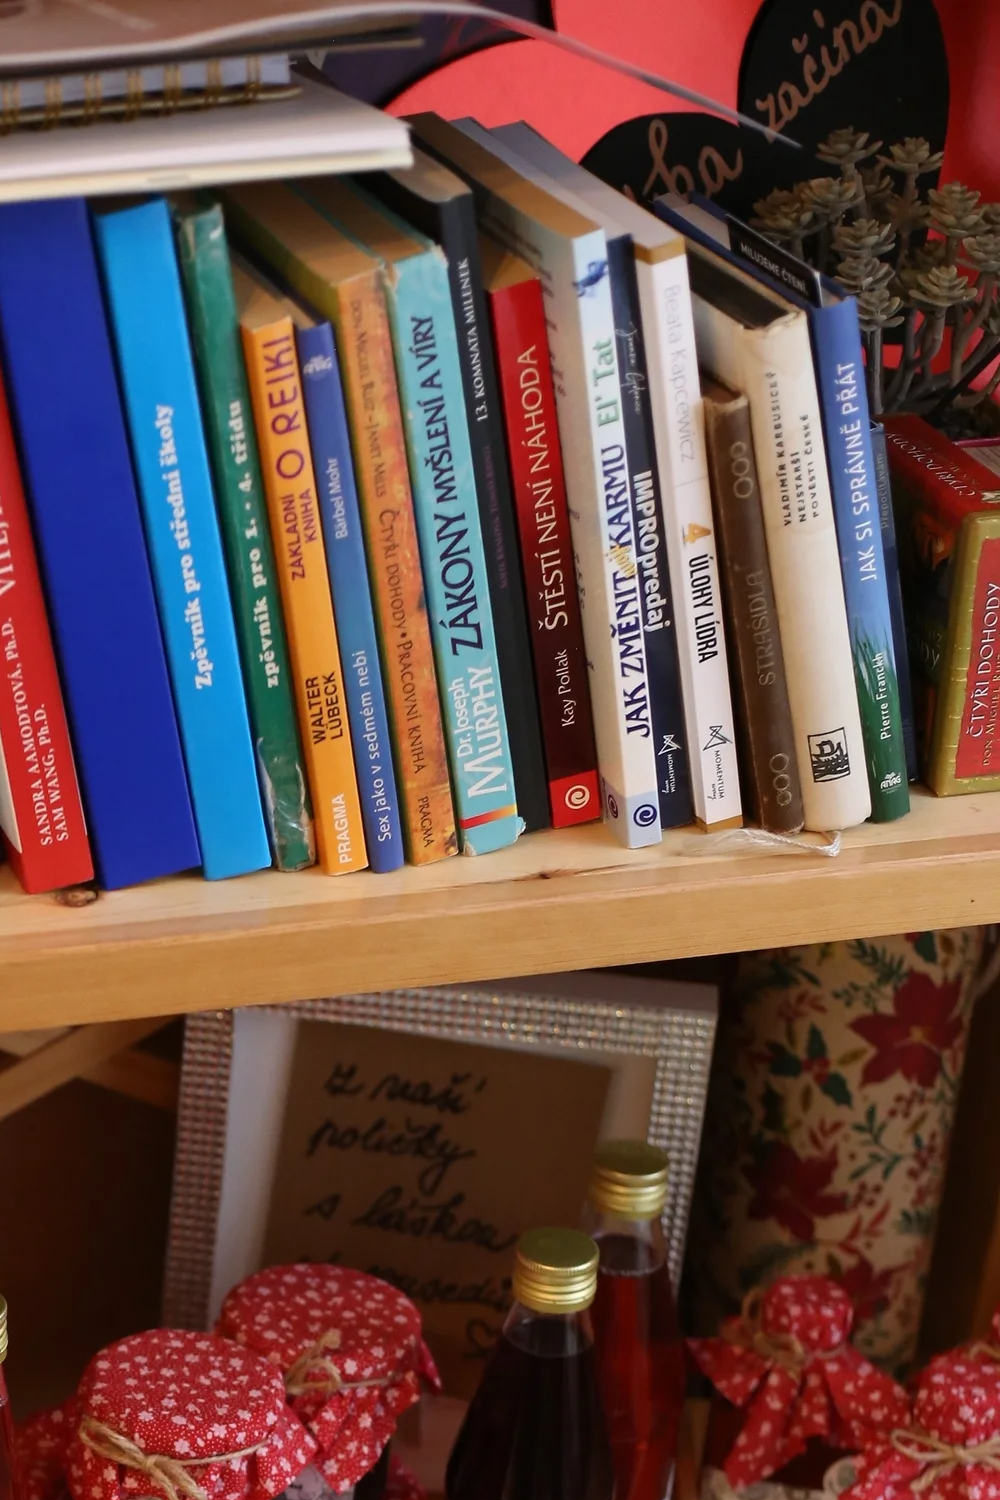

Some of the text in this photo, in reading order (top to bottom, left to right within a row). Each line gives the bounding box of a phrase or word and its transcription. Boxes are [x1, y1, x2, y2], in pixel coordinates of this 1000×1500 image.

[456, 257, 489, 422] 13. KOMNATA MILENEK
[591, 336, 616, 389] Tat
[663, 284, 695, 463] Beata Kapcewicz
[155, 403, 179, 468] školy
[262, 334, 306, 480] O REIKI
[764, 371, 792, 527] VLADIMÍR KARBUSICKÝ
[800, 413, 814, 456] ČESKÉ
[238, 472, 254, 493] 4.
[326, 457, 349, 541] Bärbel Mohr
[406, 315, 484, 656] ZÁKONY MYŠLENÍ A VÍRY
[517, 344, 569, 633] ŠTĚSTÍ NENÍ NÁHODA
[601, 443, 632, 550] KARMU
[790, 450, 807, 524] NEJSTARŠÍ
[832, 362, 878, 582] JAK SI SPRÁVNĚ PŘÁT
[245, 518, 259, 540] 1.
[301, 487, 318, 543] KNIHA
[632, 470, 672, 633] IMPROpredaj
[180, 554, 201, 594] pro
[249, 548, 268, 588] pro
[688, 553, 721, 664] ÚLOHY LÍDRA
[610, 571, 646, 678] ZMĚNIT
[966, 581, 1000, 738] ČTYŘI DOHODY
[305, 671, 344, 745] WALTER LÜBECK
[385, 561, 407, 630] DOHODY
[397, 639, 418, 723] PRACOVNÍ
[408, 725, 427, 775] KNIHA
[448, 676, 475, 736] Joseph
[554, 648, 577, 727] Kay Pollak
[624, 681, 651, 738] JAK
[871, 651, 892, 741] Pierre Franckh
[0, 616, 54, 847] SANDRA AAMODTOVÁ, Ph.D.
[33, 703, 70, 842] SAM WANG, Ph.D.
[351, 649, 392, 842] Sex jako v sedmém nebi
[463, 665, 508, 799] MURPHY
[667, 753, 676, 793] MOMENTUM
[982, 740, 994, 767] DON
[714, 750, 725, 799] MOMENTUM
[331, 793, 353, 865] PRAGMA
[417, 795, 435, 850] PRAGMA
